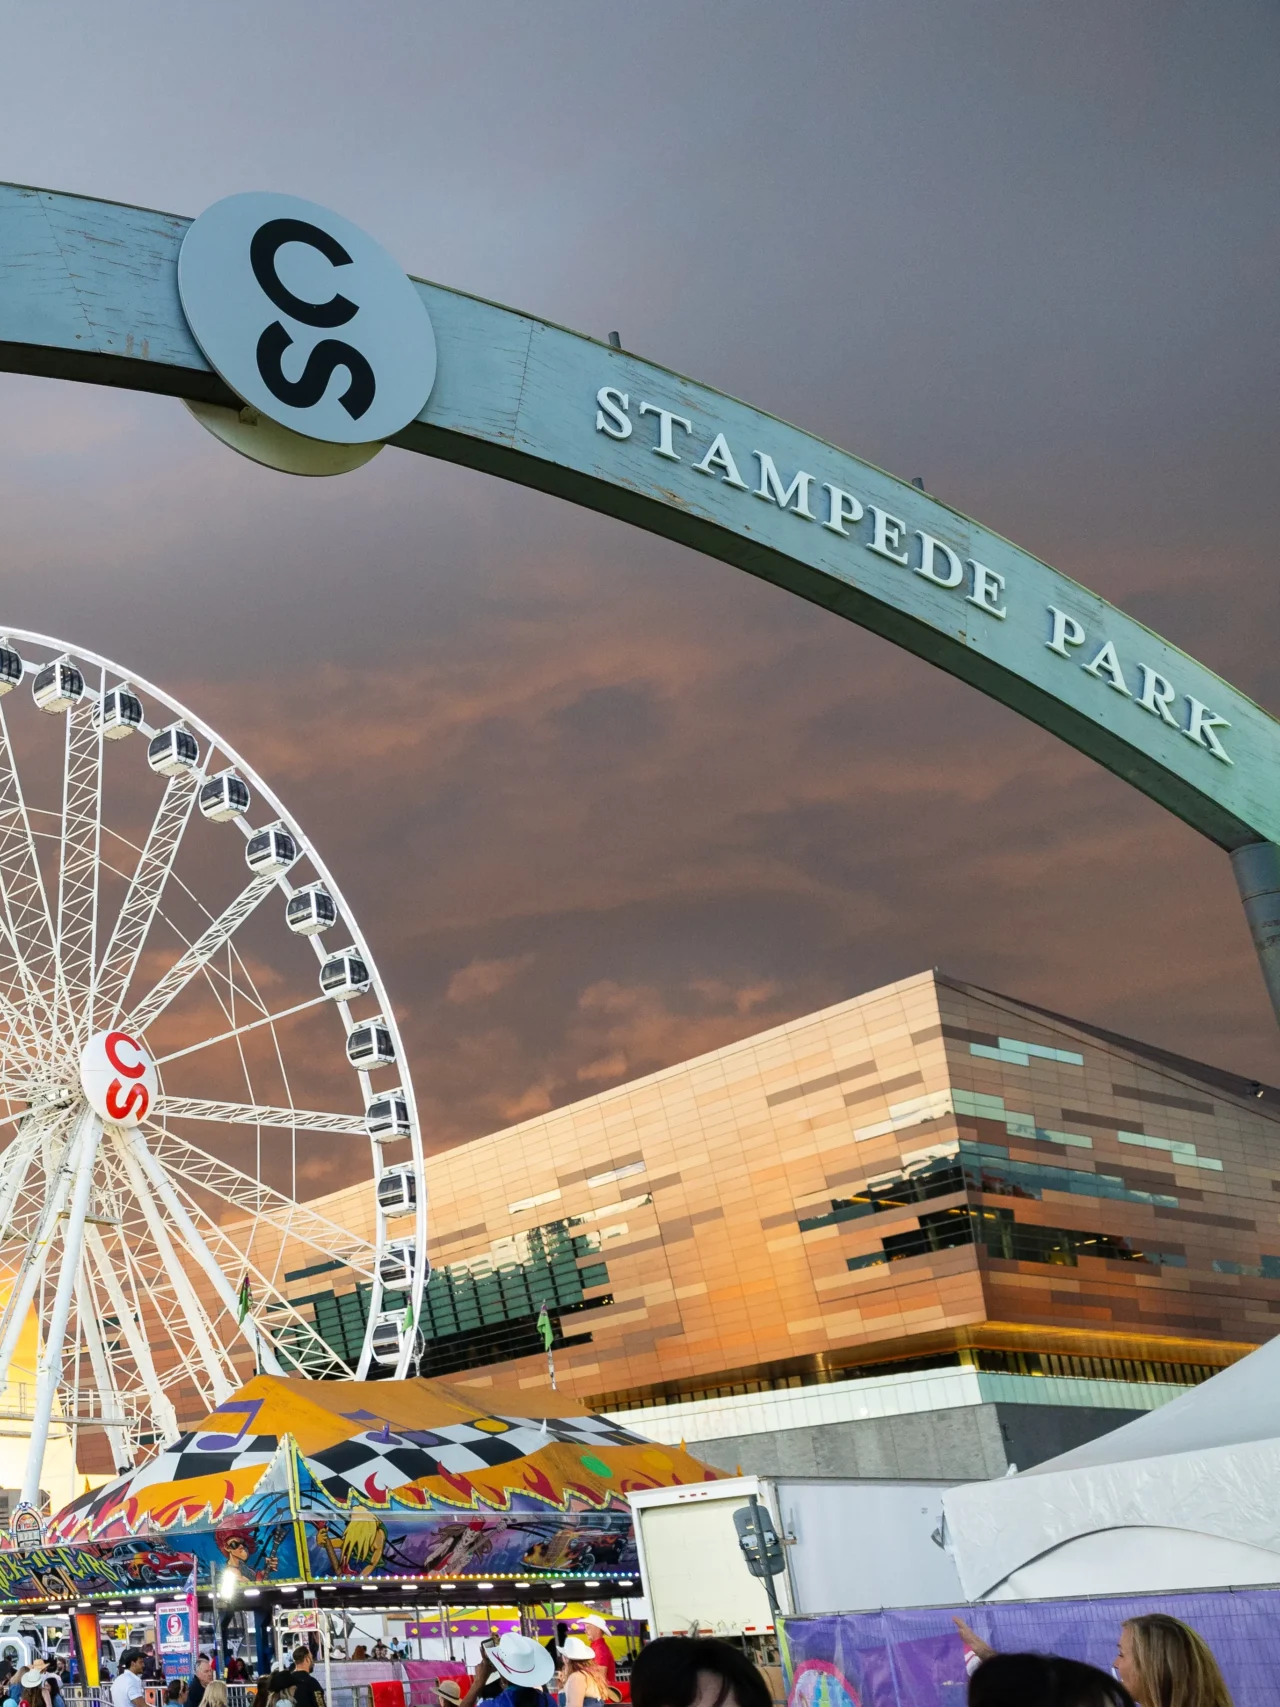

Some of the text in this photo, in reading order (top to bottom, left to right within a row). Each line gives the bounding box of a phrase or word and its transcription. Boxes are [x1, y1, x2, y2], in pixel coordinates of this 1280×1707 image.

[250, 218, 376, 421] CS
[596, 386, 1234, 766] STAMPEDE PARK
[105, 1031, 149, 1121] CS
[170, 1615, 179, 1634] 5
